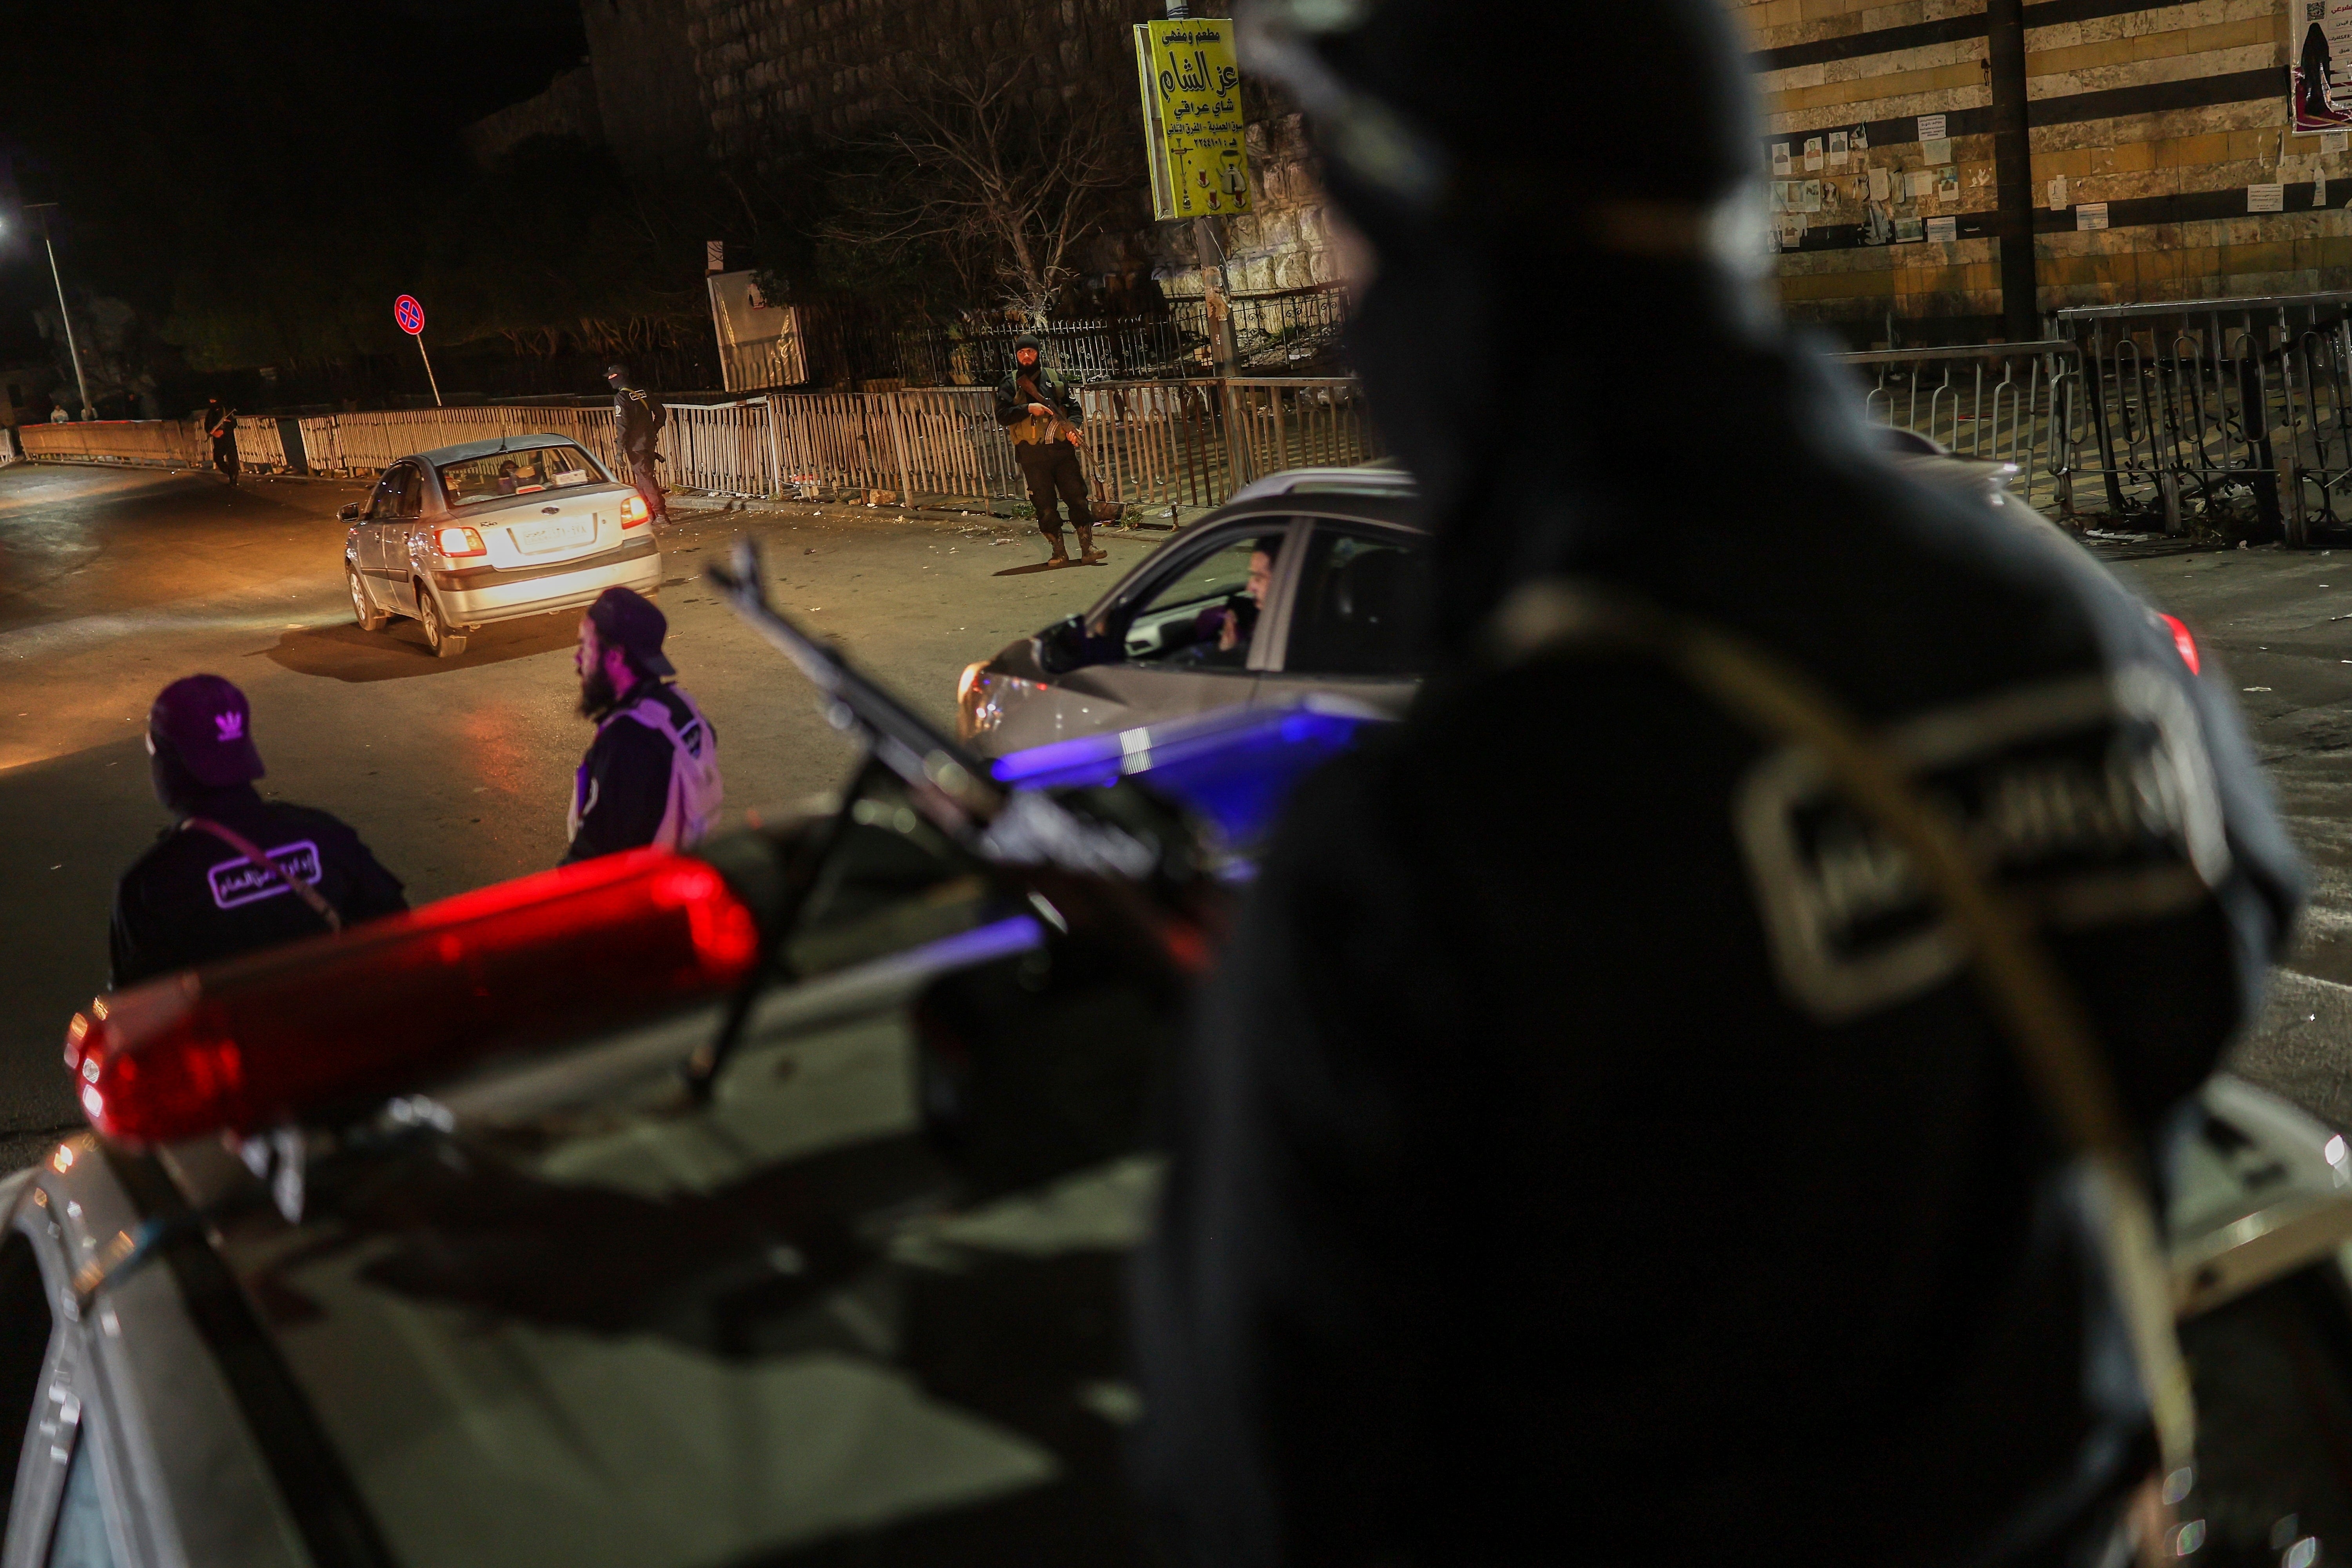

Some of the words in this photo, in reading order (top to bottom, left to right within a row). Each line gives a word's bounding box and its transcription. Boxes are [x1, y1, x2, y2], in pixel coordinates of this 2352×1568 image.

[1196, 27, 1220, 45] مطعم
[1160, 50, 1213, 102] الشام
[1216, 65, 1238, 96] عز
[1174, 100, 1209, 120] عراقي
[1212, 98, 1234, 117] شاي
[1167, 122, 1184, 138] الثاني
[1185, 122, 1201, 135] المفرق
[1231, 121, 1243, 132] سوق
